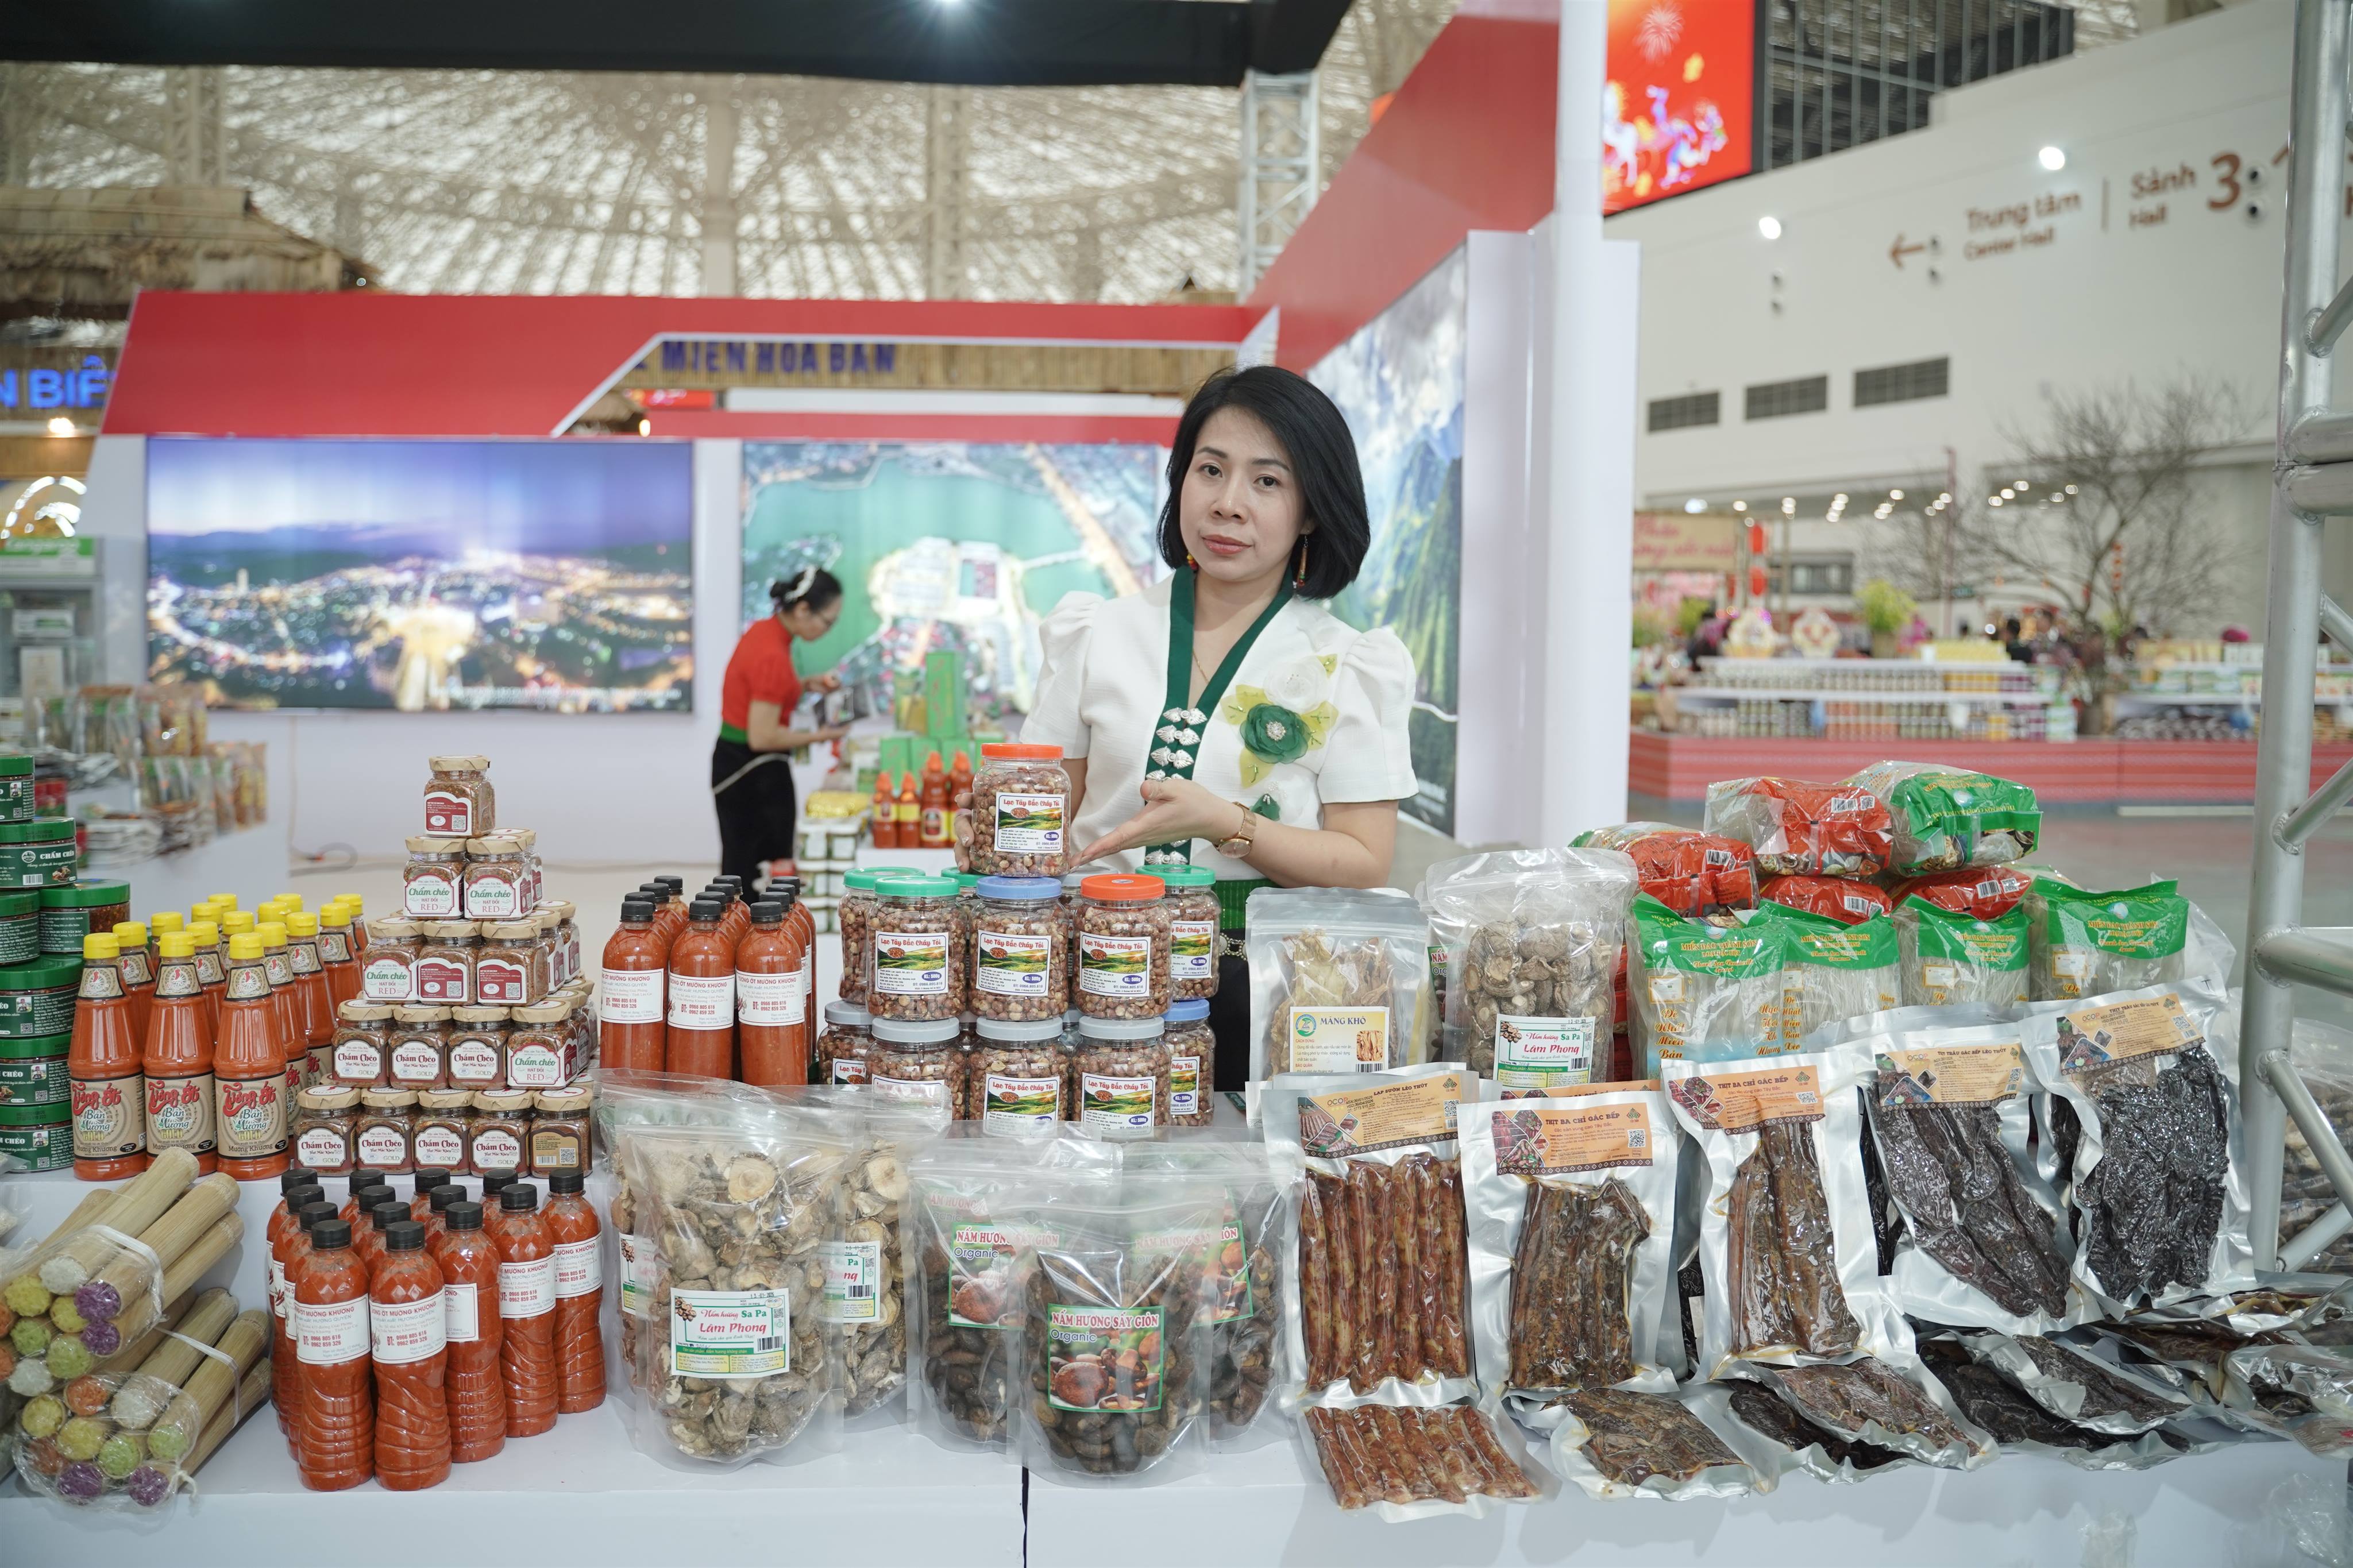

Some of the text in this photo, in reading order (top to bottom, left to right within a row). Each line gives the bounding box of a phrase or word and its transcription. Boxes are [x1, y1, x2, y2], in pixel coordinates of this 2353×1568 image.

[1965, 190, 2082, 234] Trung tâm
[2130, 205, 2168, 229] Hall
[1964, 225, 2055, 261] Center Hall
[757, 342, 818, 373] HOA
[829, 343, 895, 373] BAN
[29, 354, 117, 408] BIÊ
[1004, 799, 1014, 809] Lạc
[1016, 799, 1027, 807] Tây
[1028, 798, 1039, 807] Bắc
[40, 851, 61, 860] CHẤM
[1175, 925, 1187, 933] Bắc
[1187, 926, 1201, 934] Cháy
[881, 938, 890, 946] Lạc
[902, 938, 915, 946] Bắc
[1085, 939, 1093, 948] Lạc
[1094, 940, 1104, 949] Tây
[1105, 940, 1116, 949] Bắc
[1117, 941, 1133, 951] Cháy
[1347, 1015, 1366, 1025] KHÔ
[2082, 1012, 2100, 1022] OCOP
[1523, 1044, 1580, 1055] Lâm Phong
[360, 1053, 377, 1062] Chéo
[418, 1055, 436, 1063] Chéo
[476, 1054, 495, 1063] Chéo
[1088, 1080, 1098, 1088] Lạc
[1098, 1082, 1110, 1090] Tây
[1111, 1082, 1123, 1090] Bắc
[1326, 1096, 1348, 1106] OCOP
[323, 1141, 342, 1149] Chéo
[499, 1144, 517, 1152] Chéo
[956, 1227, 978, 1244] NẤM
[953, 1246, 999, 1260] Organic
[741, 1310, 753, 1318] Sa
[755, 1309, 767, 1318] Pa
[1052, 1310, 1160, 1328] NẤM HƯƠNG SẤY GIÒN
[700, 1322, 767, 1334] Lâm Phong
[1050, 1328, 1097, 1343] Organic
